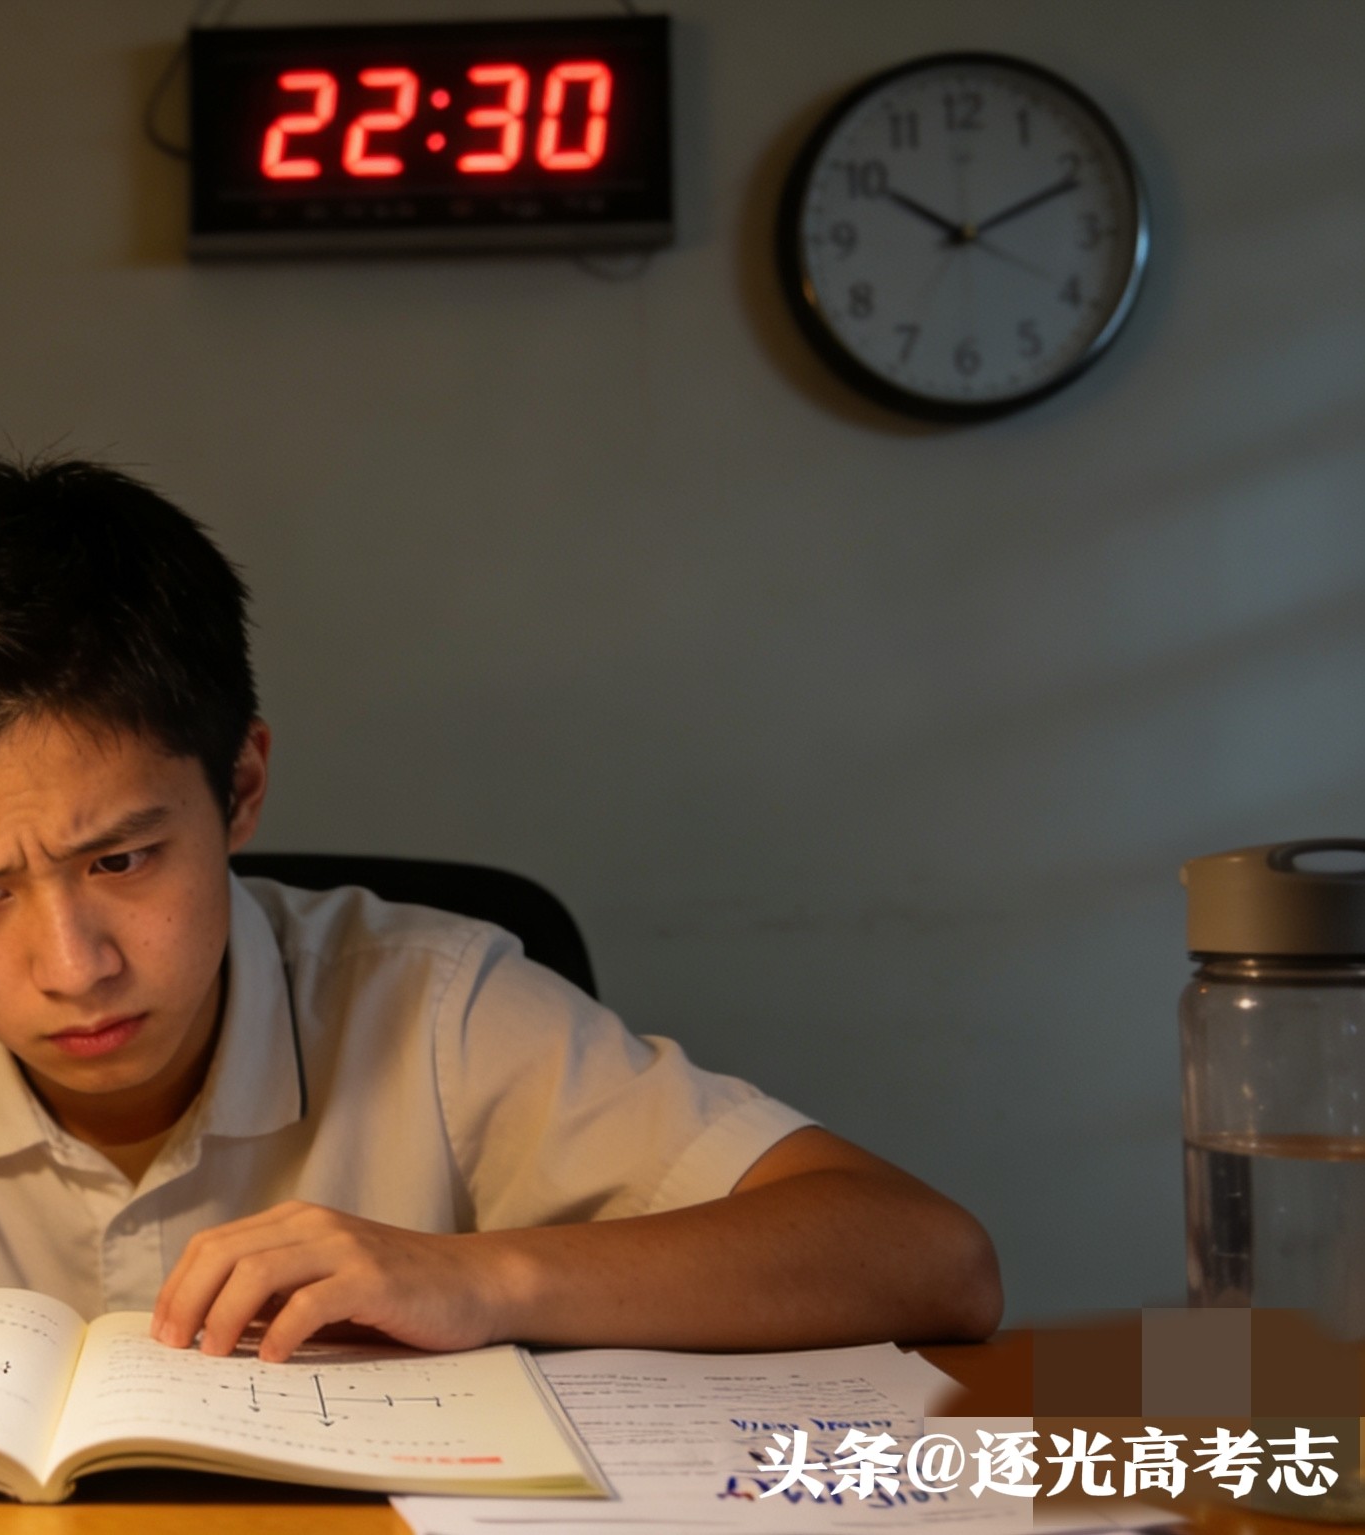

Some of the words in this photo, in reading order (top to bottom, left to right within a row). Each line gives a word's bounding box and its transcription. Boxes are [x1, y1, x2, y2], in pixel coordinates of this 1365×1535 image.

[261, 61, 613, 179] 22:30
[888, 111, 919, 149] 11
[943, 92, 983, 131] 12
[1016, 107, 1030, 147] 1
[844, 160, 889, 199] 10
[1055, 152, 1082, 188] 2
[830, 221, 858, 260] 9
[1081, 212, 1100, 249] 3
[848, 281, 874, 320] 8
[1057, 274, 1082, 309] 4
[894, 324, 922, 364] 7
[952, 337, 982, 377] 6
[1016, 319, 1043, 358] 5
